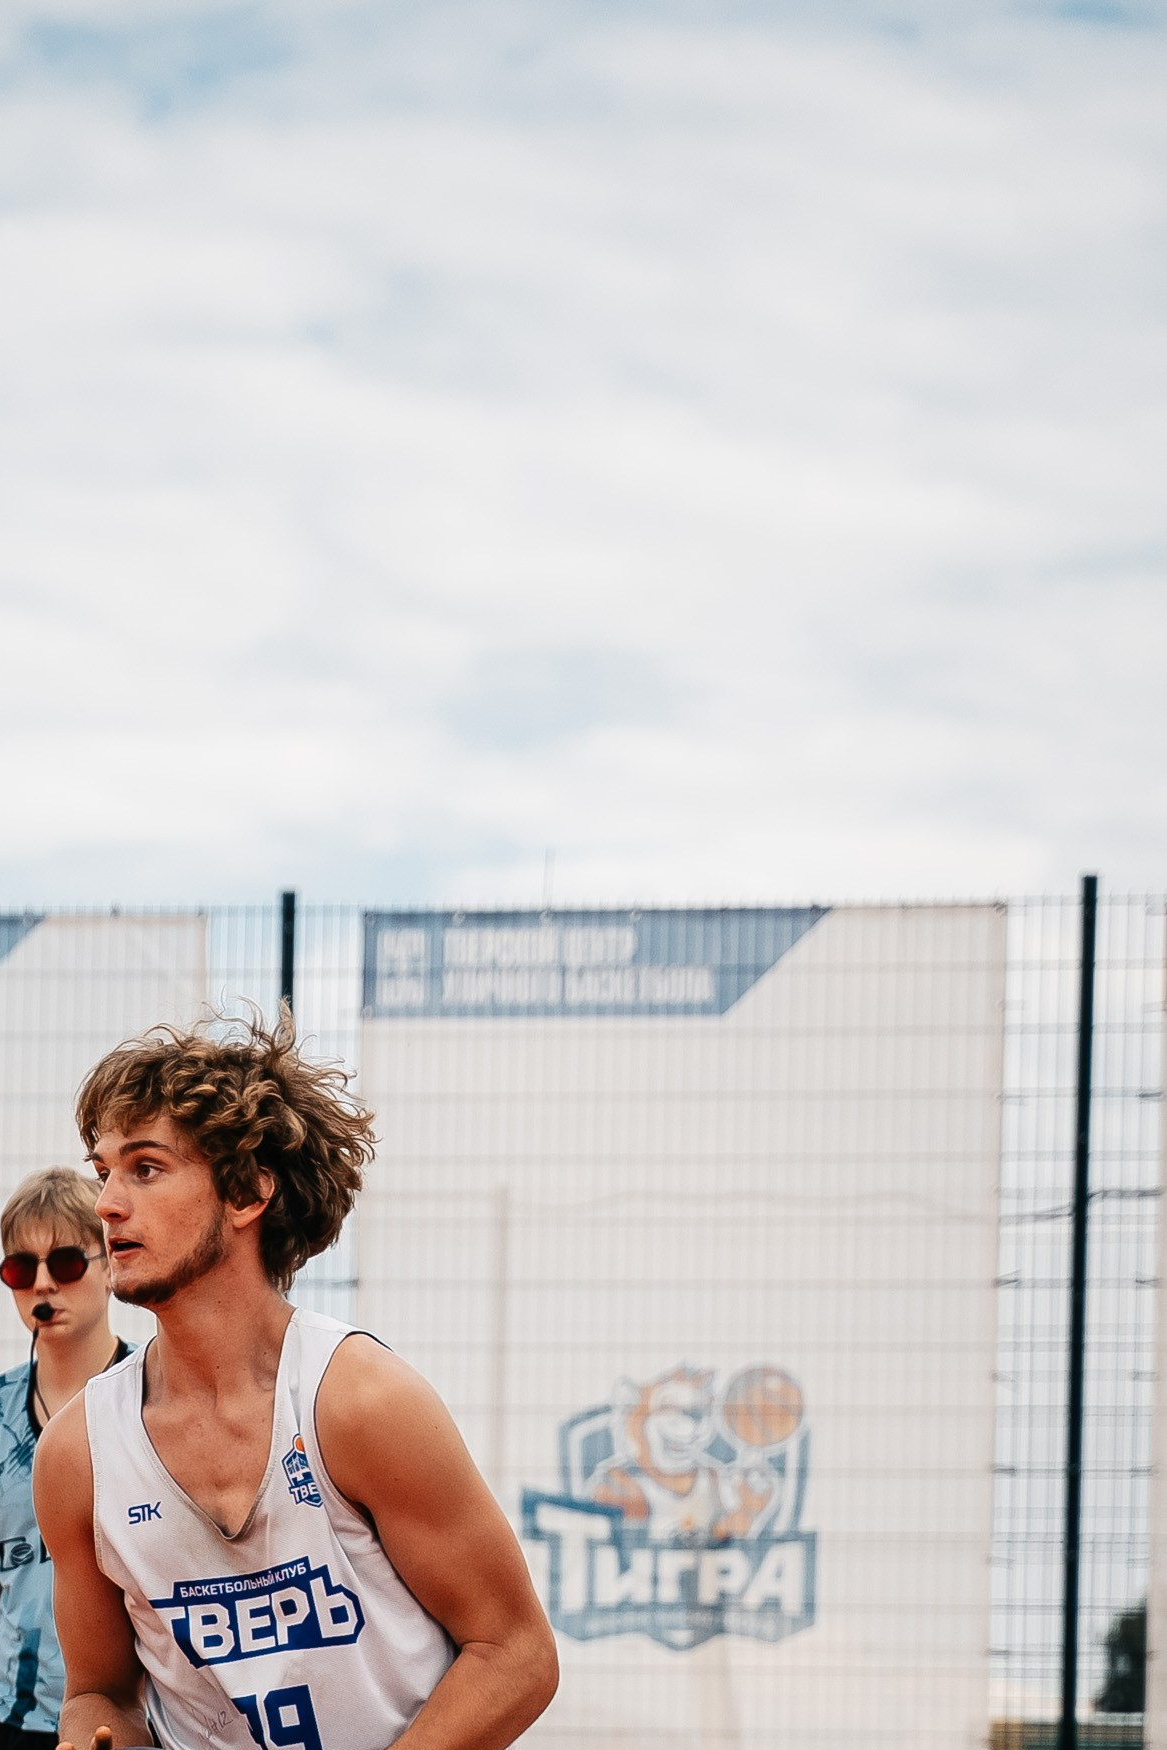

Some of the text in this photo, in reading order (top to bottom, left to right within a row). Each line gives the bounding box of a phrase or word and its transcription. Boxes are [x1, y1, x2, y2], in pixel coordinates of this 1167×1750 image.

[128, 1501, 163, 1525] STK
[179, 1562, 308, 1598] БАСКЕТБОЛЬНЫЙ КЛУБ
